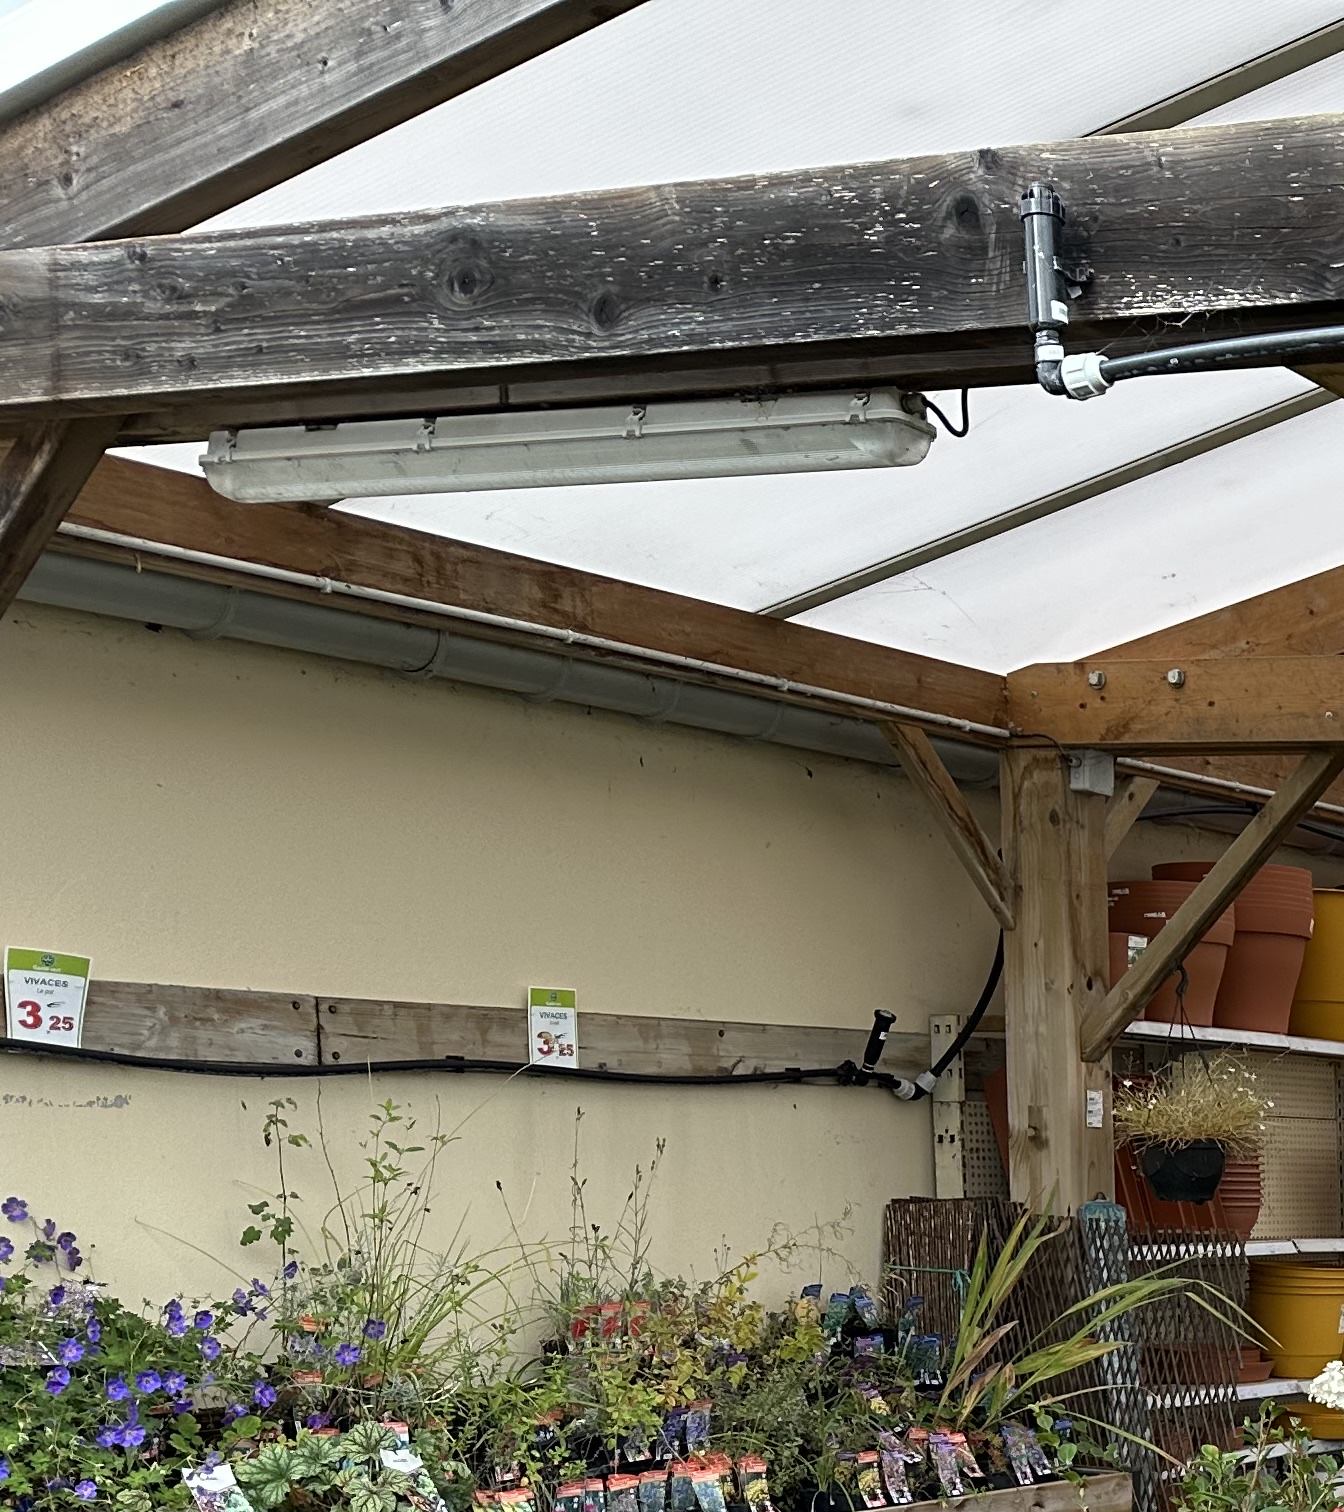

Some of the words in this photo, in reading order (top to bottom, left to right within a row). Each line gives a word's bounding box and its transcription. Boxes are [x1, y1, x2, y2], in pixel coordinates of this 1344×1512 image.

[24, 976, 69, 988] VIVACES
[17, 999, 43, 1030] 3
[48, 1015, 75, 1032] 25
[539, 1011, 568, 1020] VIVACES
